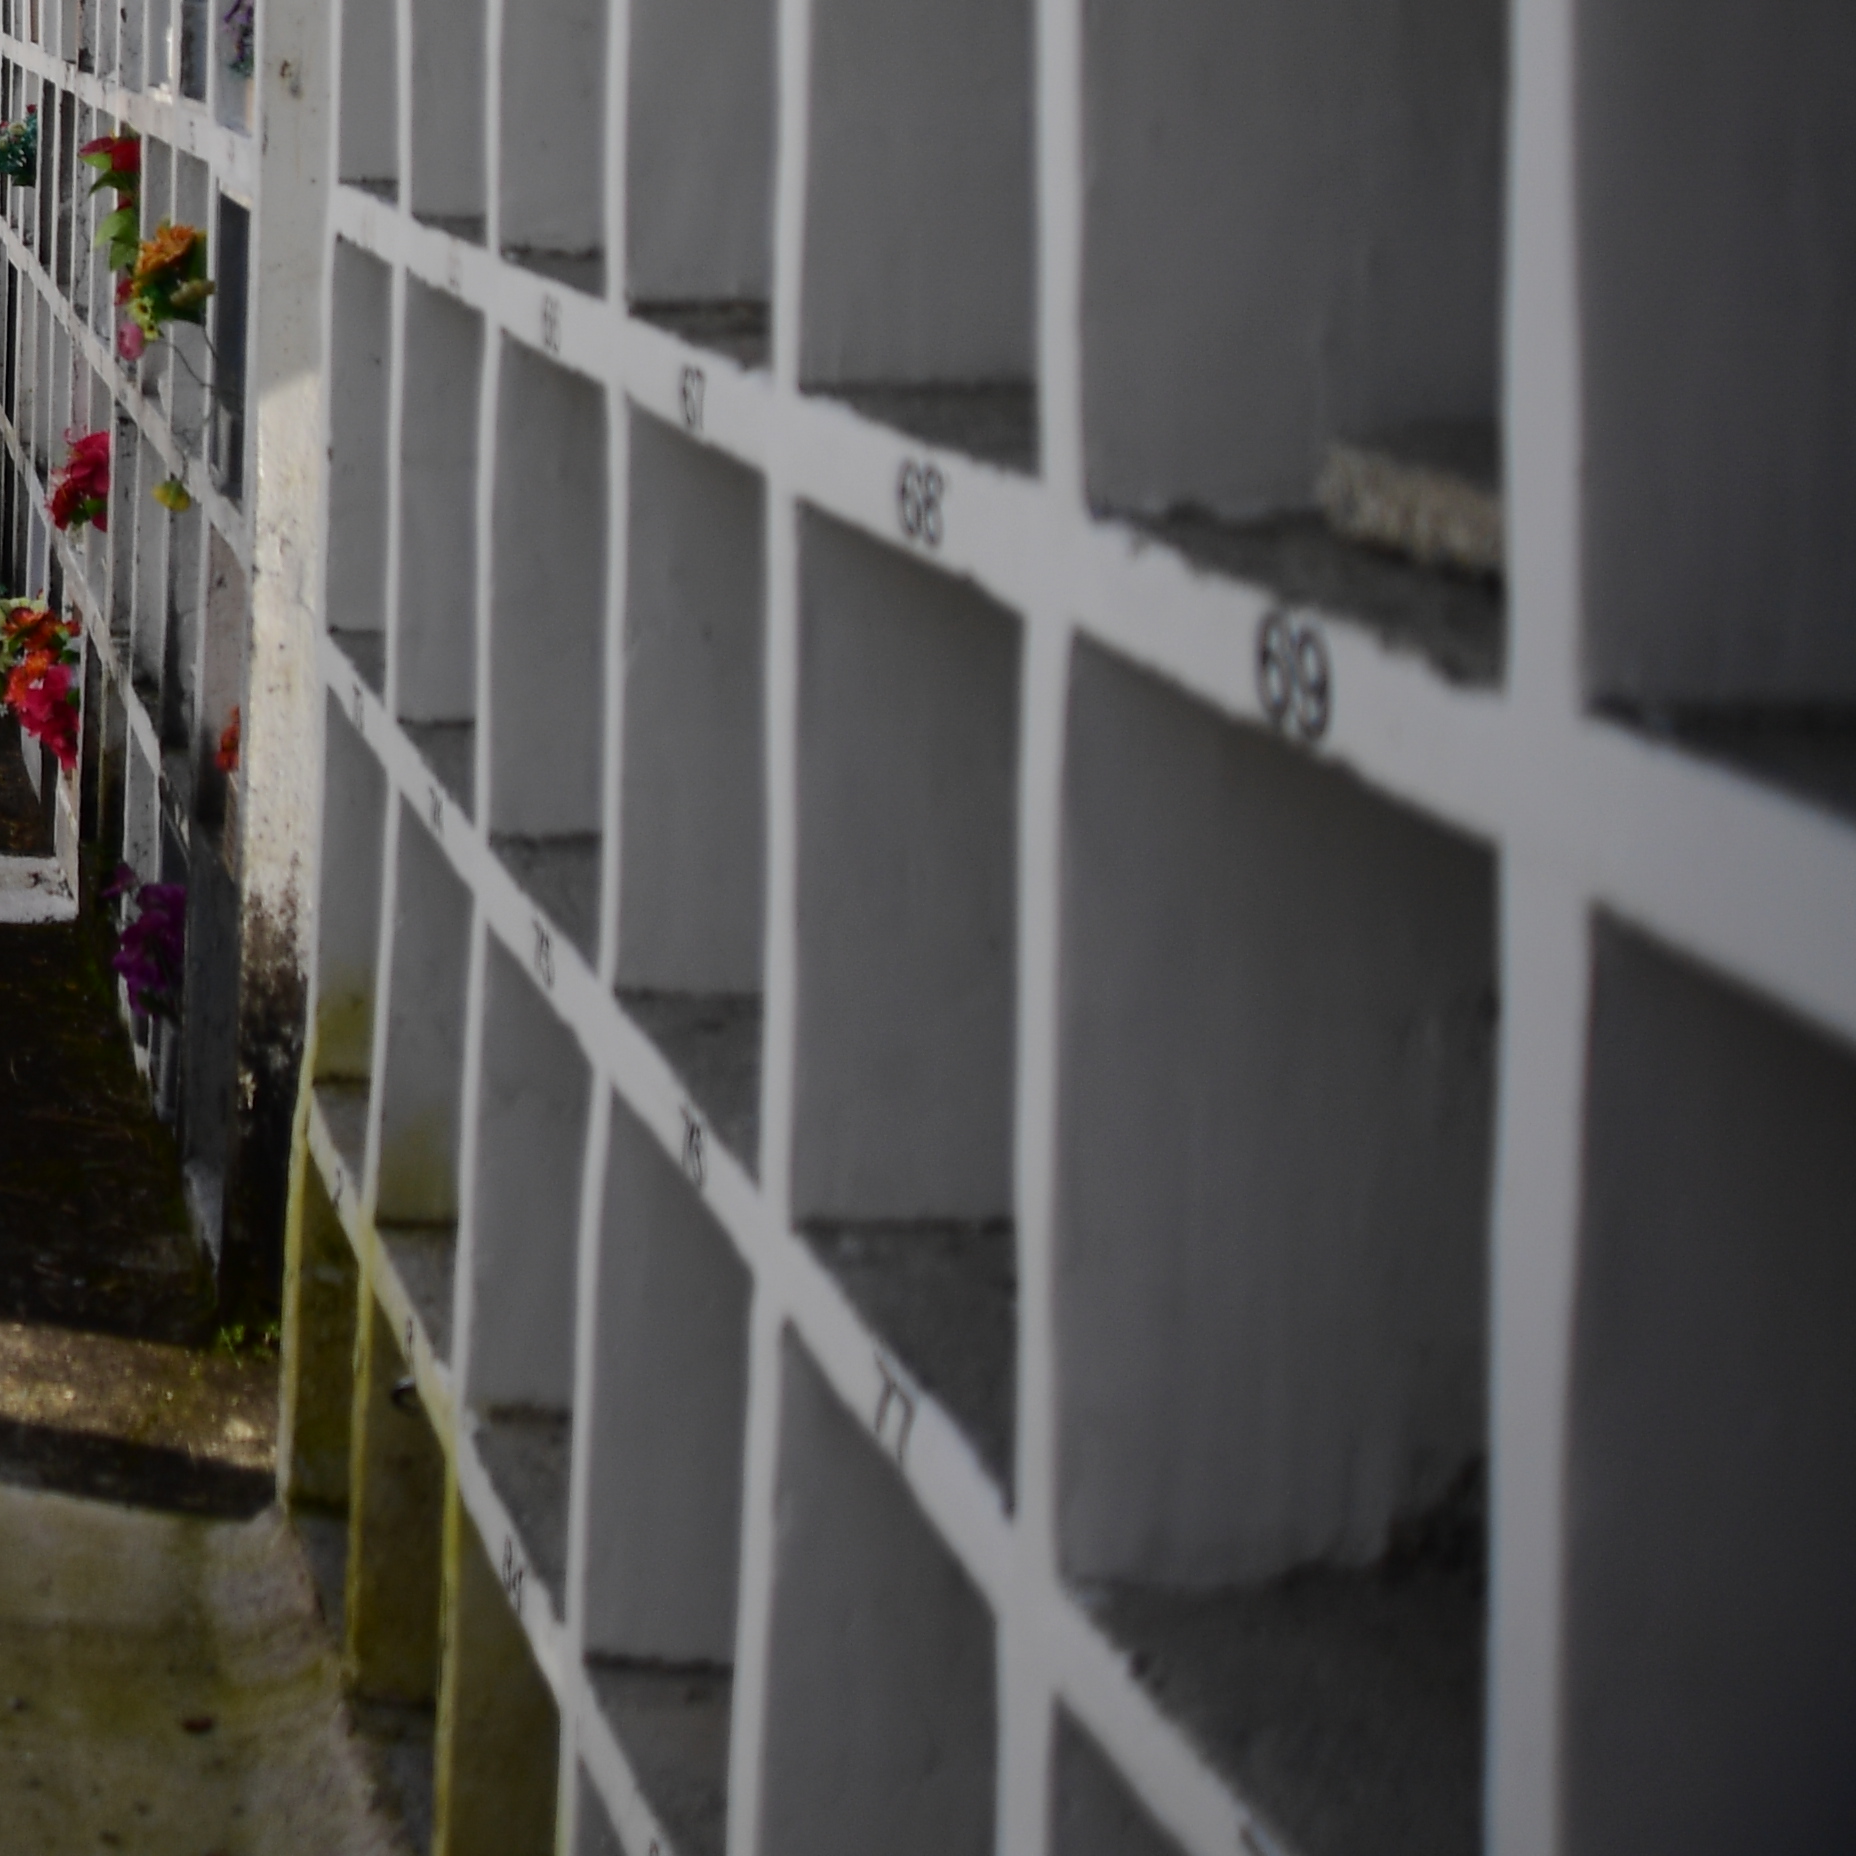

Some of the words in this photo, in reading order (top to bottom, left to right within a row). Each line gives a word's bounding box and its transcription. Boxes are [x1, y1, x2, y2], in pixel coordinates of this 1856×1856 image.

[897, 459, 944, 548] 68
[1257, 608, 1333, 741] 69
[875, 1356, 915, 1465] 77
